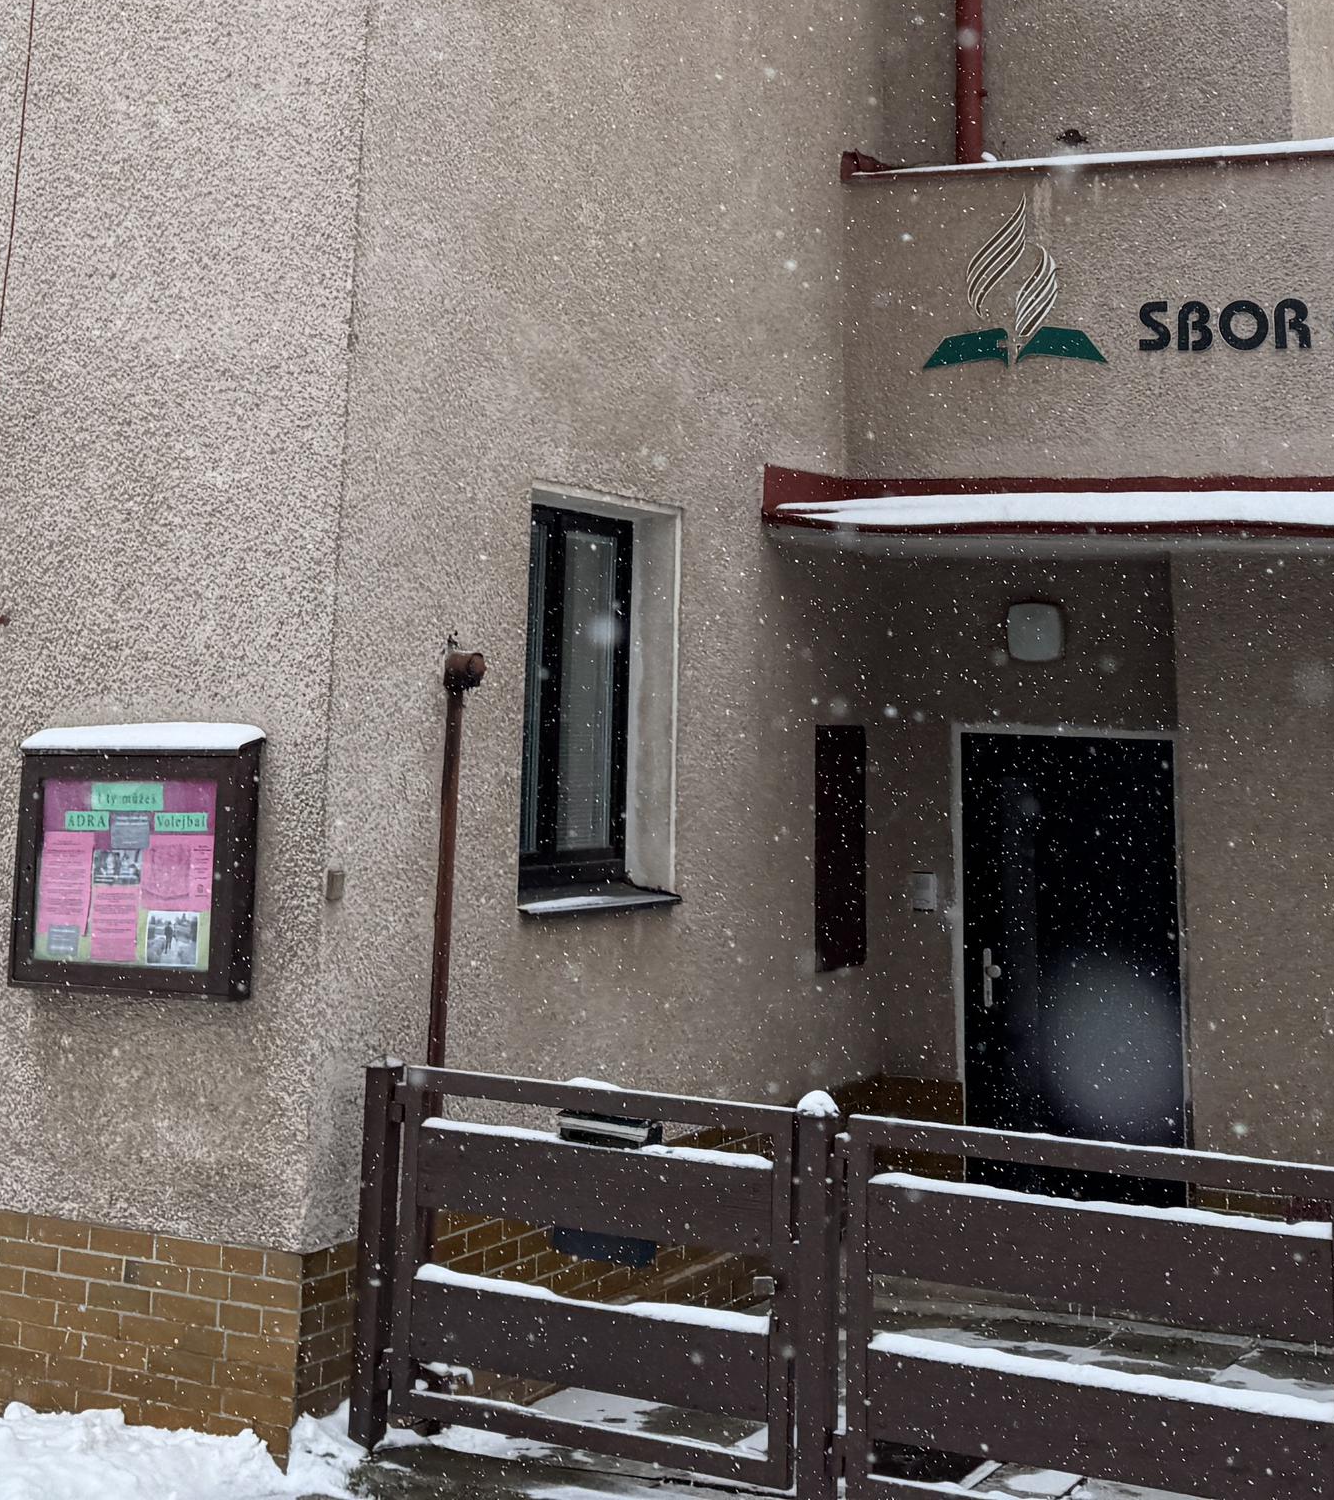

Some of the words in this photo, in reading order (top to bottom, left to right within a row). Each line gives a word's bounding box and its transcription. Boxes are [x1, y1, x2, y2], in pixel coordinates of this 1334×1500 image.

[1138, 299, 1312, 352] SBOR
[67, 815, 107, 828] ADRA
[156, 815, 206, 831] Volejbal
